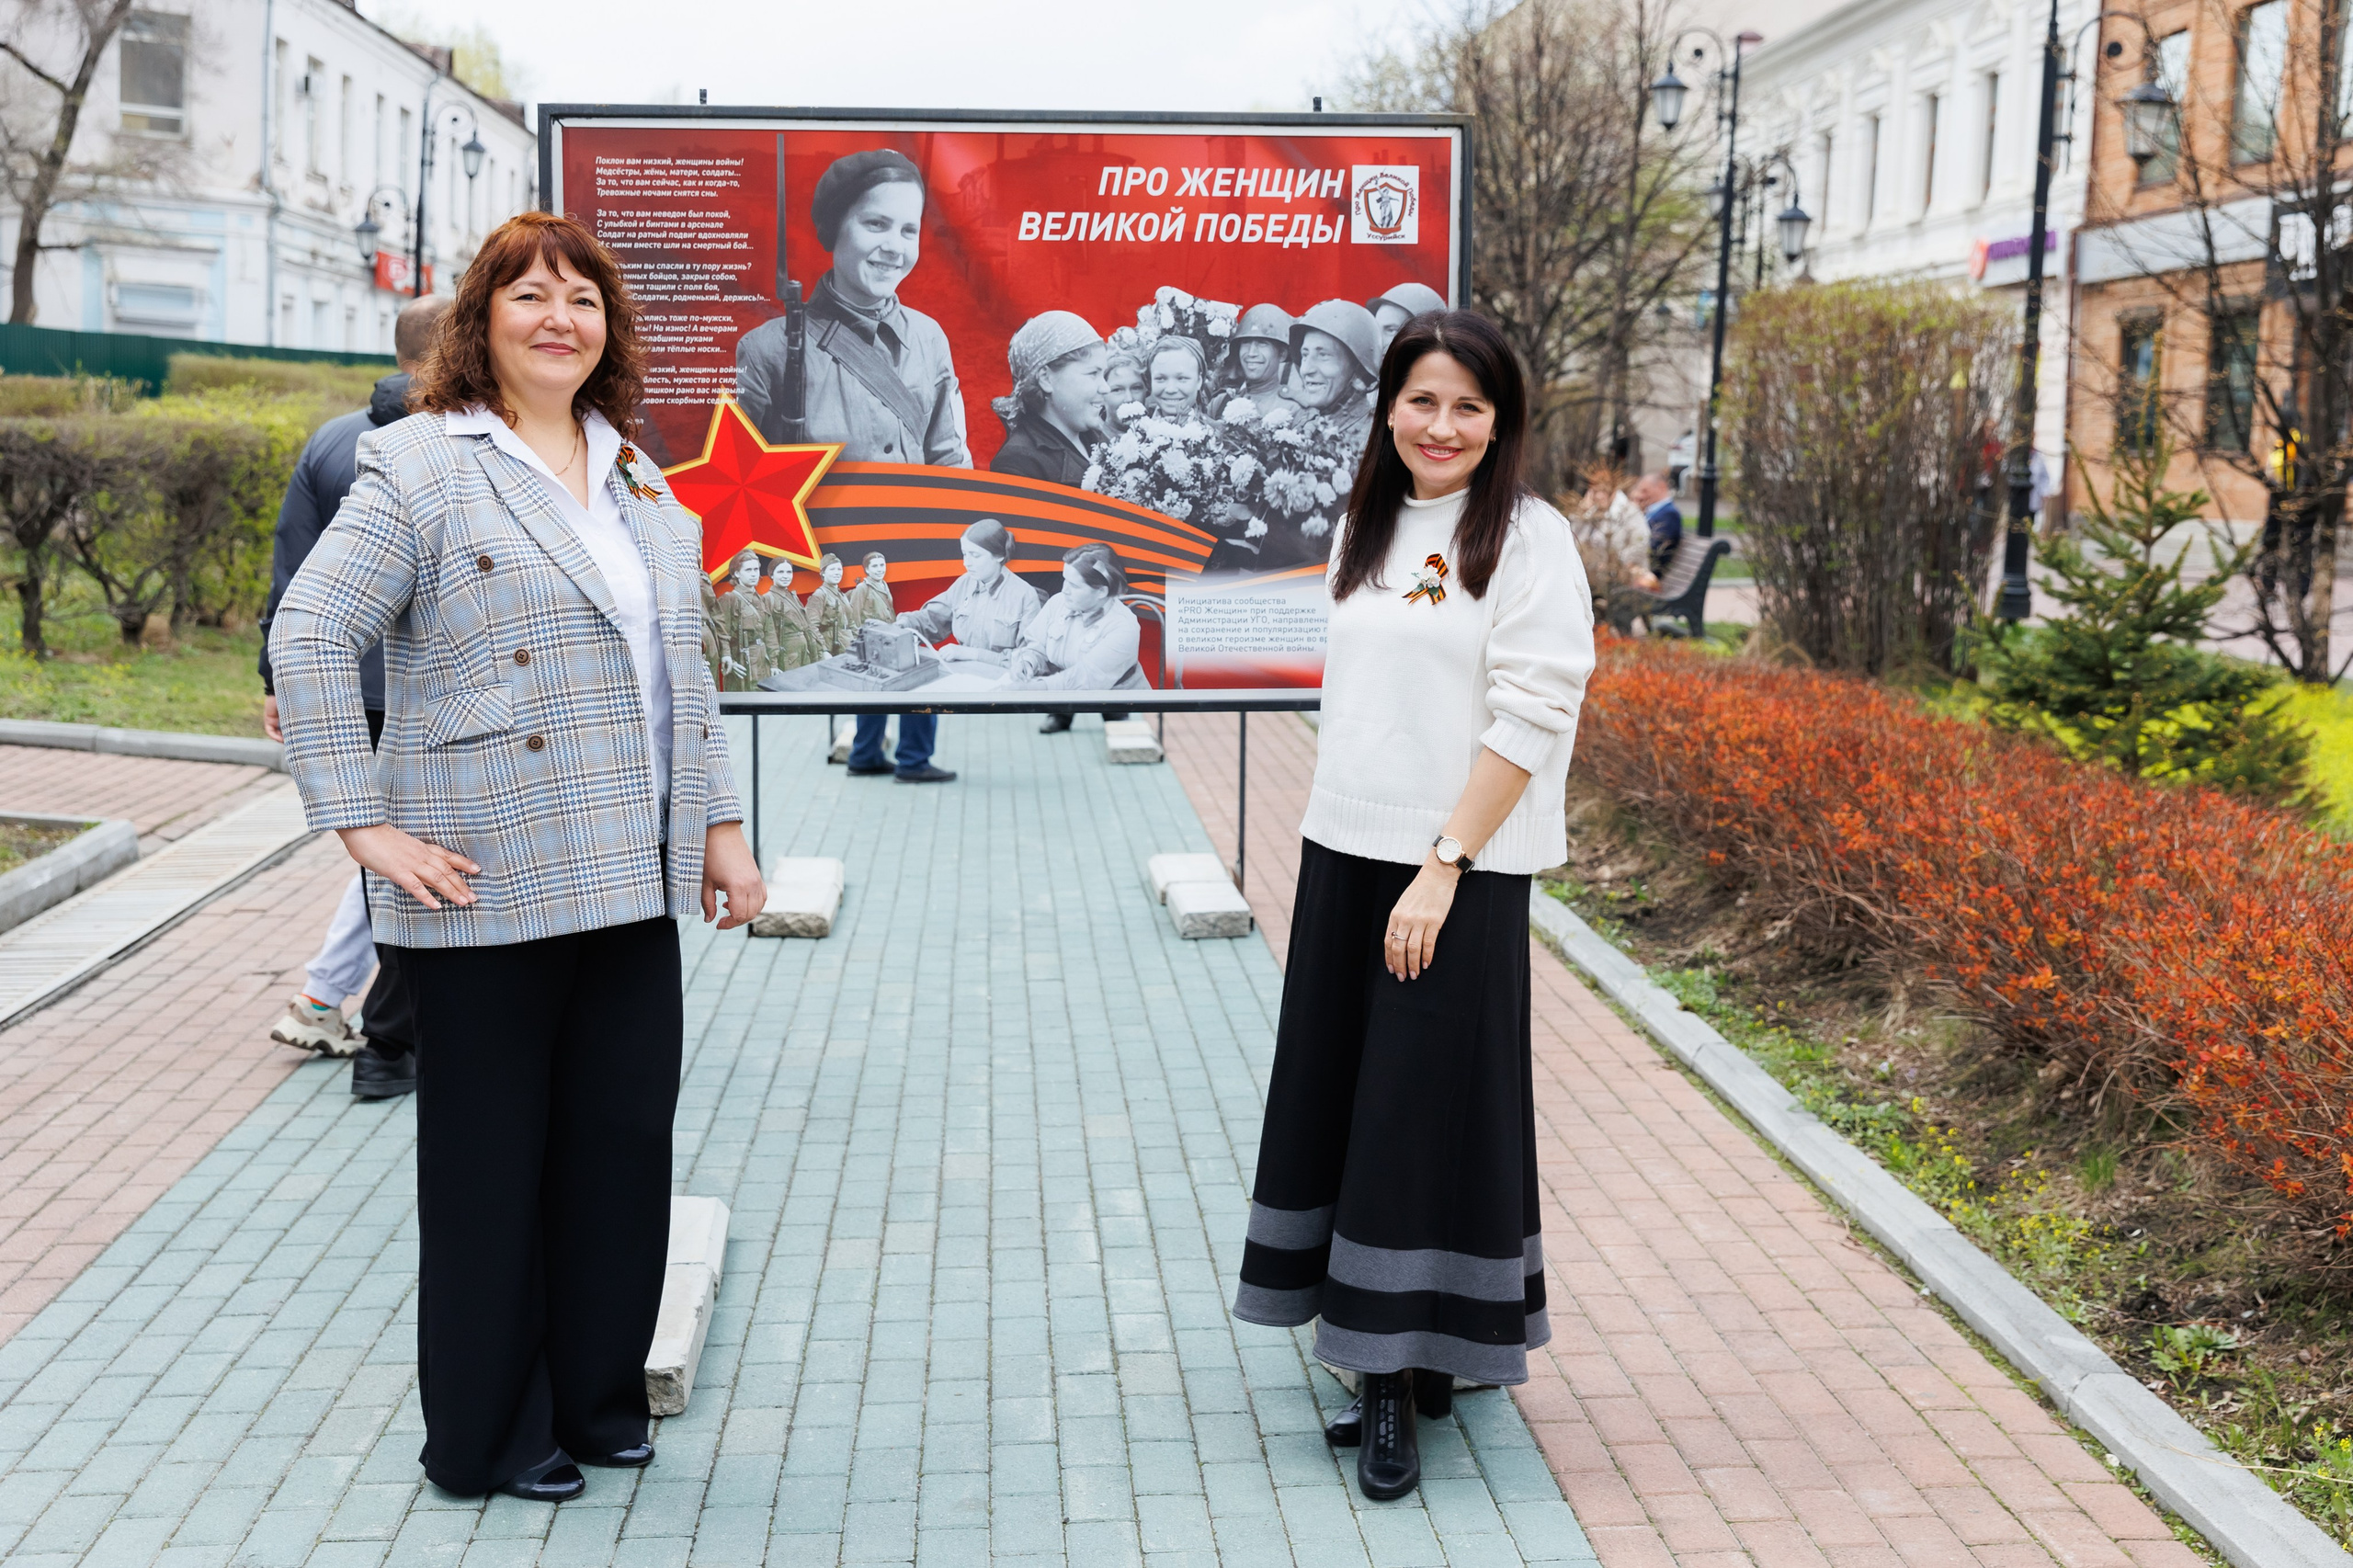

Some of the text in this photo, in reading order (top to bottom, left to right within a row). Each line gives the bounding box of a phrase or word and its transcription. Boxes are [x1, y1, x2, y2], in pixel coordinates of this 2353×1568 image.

[596, 156, 624, 165] Поклон
[643, 157, 674, 165] низкий,
[675, 158, 714, 166] женщины
[715, 157, 744, 165] войны!
[596, 166, 642, 176] Медсёстры,
[643, 167, 667, 176] жёны,
[669, 169, 699, 177] матери,
[596, 177, 606, 186] За
[608, 178, 619, 187] то,
[652, 178, 681, 187] сейчас,
[1380, 172, 1409, 187] Великой
[1098, 166, 1346, 203] ПРО ЖЕНЩИН
[597, 187, 641, 198] Тревожные
[597, 209, 607, 217] За
[688, 210, 704, 218] был
[705, 210, 731, 219] покой,
[597, 220, 603, 228] С
[604, 220, 637, 229] улыбкой
[645, 220, 679, 228] бинтами
[687, 222, 724, 230] арсенале
[1017, 206, 1345, 249] ВЕЛИКОЙ ПОБЕДЫ
[597, 230, 626, 238] Солдат
[638, 231, 667, 240] ратный
[1367, 233, 1405, 241] Уссурийск
[693, 242, 732, 251] смертный
[722, 262, 752, 270] жизнь?
[649, 272, 679, 280] бойцов,
[711, 273, 737, 281] собою,
[704, 283, 720, 291] боя,
[673, 294, 722, 302] родненький,
[689, 315, 733, 324] по-мужски,
[667, 345, 696, 353] тёплые
[719, 366, 747, 374] войны!
[643, 376, 671, 384] блесть,
[666, 396, 705, 405] скорбным
[1178, 597, 1286, 606] Инициатива сообщества
[1178, 606, 1316, 616] «PRO Женщин» при поддержке
[1177, 616, 1328, 625] Администрации УГО, направленна
[1225, 636, 1266, 644] героизме
[1178, 644, 1317, 653] Великой Отечественной войны.
